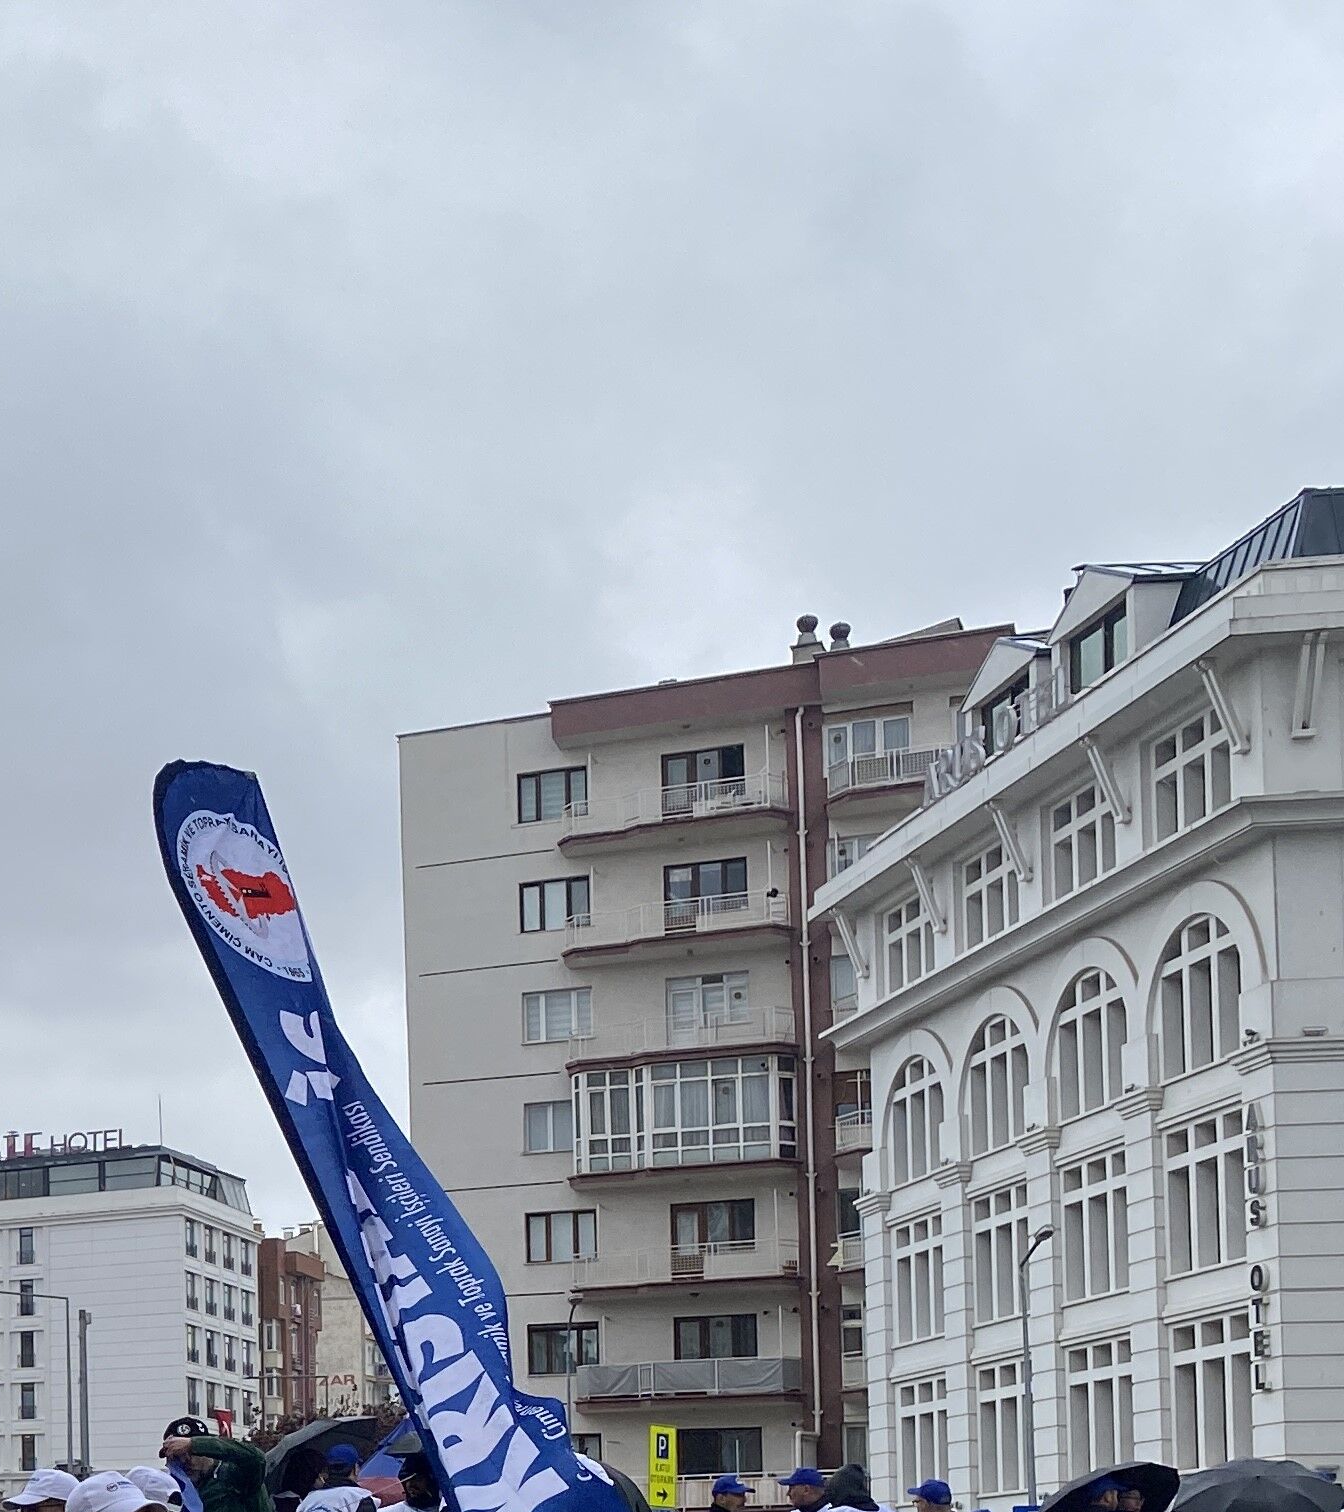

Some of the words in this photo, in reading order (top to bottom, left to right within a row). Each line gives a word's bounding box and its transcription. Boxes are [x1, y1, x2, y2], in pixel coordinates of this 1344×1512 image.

[50, 1128, 125, 1155] HOTEL
[341, 1099, 398, 1174] Sendikası
[1246, 1102, 1267, 1228] ARUS
[436, 1256, 487, 1307] Toprak
[473, 1301, 498, 1322] ve
[1250, 1263, 1273, 1392] OTEL
[658, 1435, 668, 1457] P
